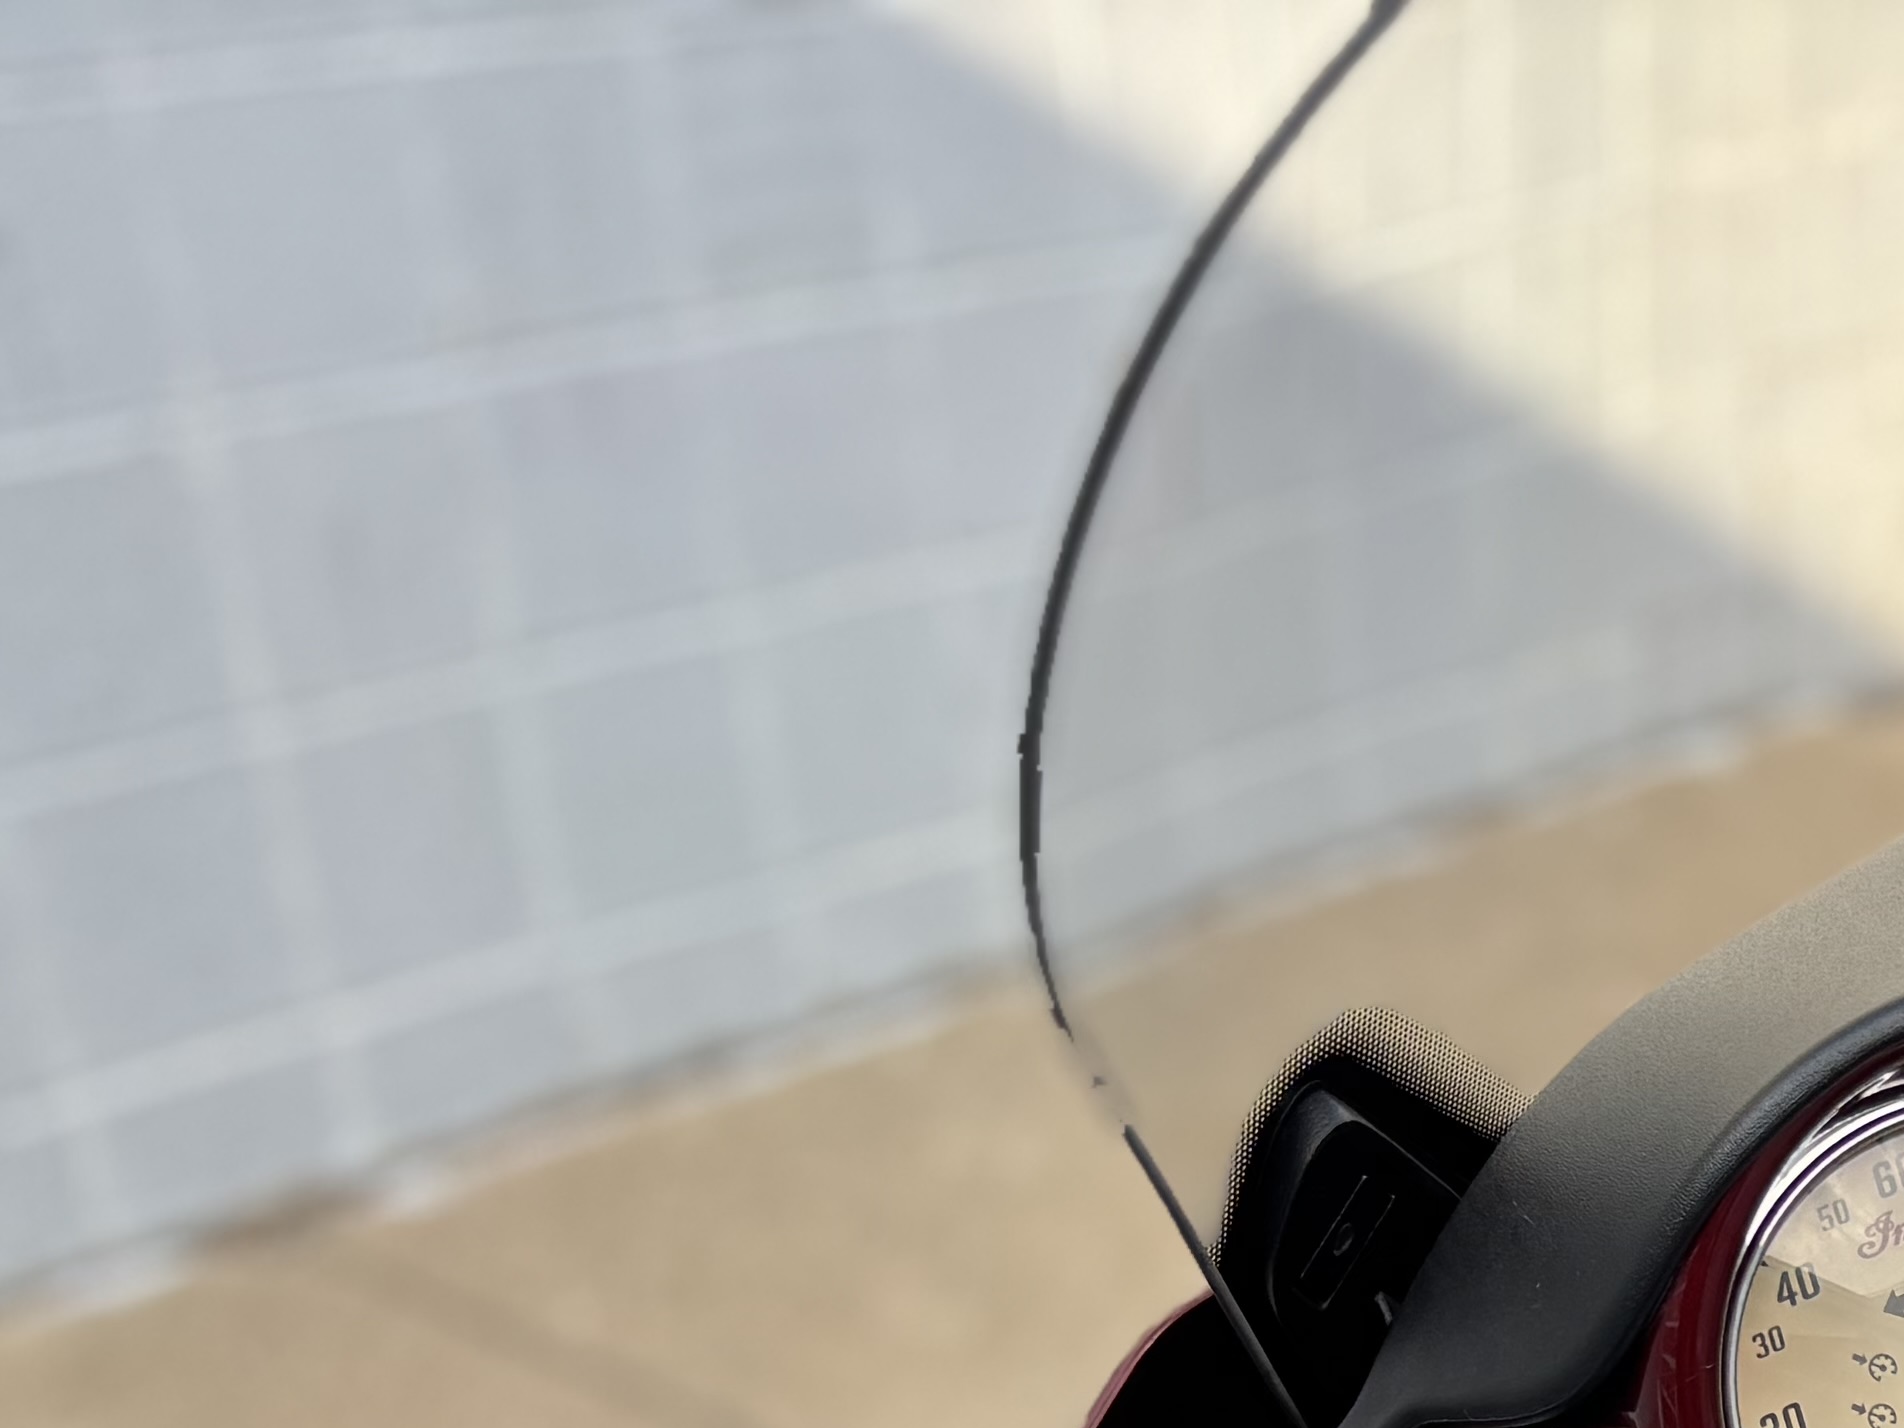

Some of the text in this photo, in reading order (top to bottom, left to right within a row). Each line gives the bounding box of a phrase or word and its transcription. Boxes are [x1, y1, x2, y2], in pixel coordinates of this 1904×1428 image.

[1816, 1197, 1850, 1232] 50
[1776, 1262, 1821, 1307] 40
[1752, 1324, 1786, 1359] 30
